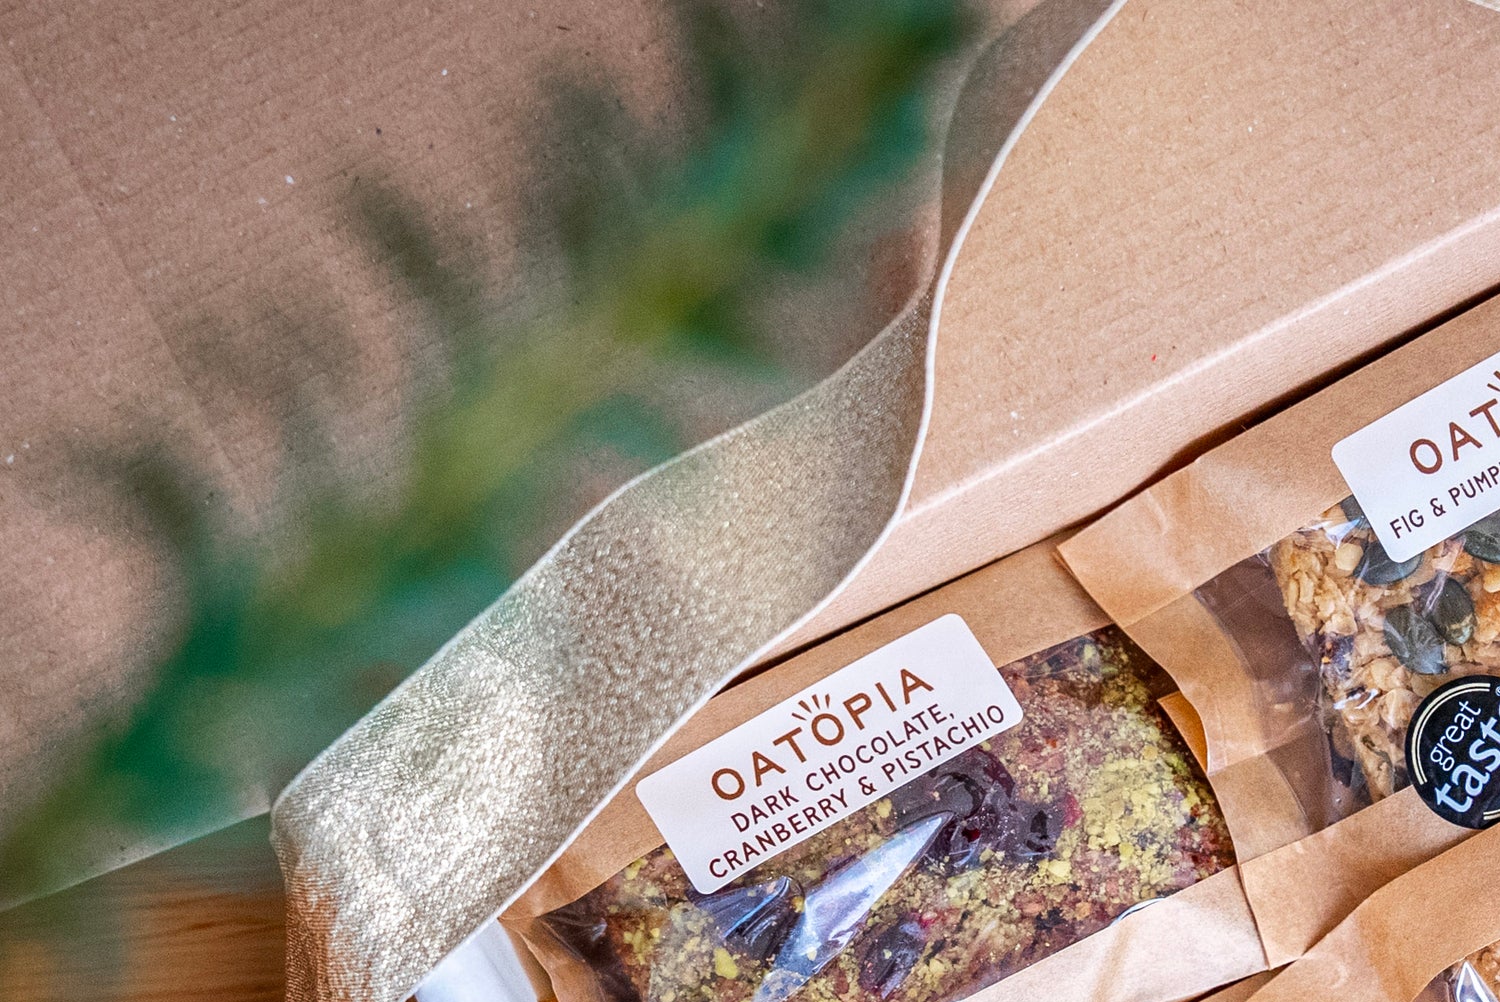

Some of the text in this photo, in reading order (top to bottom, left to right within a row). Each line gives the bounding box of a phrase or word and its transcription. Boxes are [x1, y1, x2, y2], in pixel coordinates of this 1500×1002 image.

[1389, 508, 1425, 539] FIG
[1431, 497, 1447, 517] &
[709, 704, 1005, 879] CRANBERRY & PISTACHIO
[711, 667, 935, 801] OATOPIA
[730, 703, 956, 833] DARK CHOCOLATE,
[1430, 700, 1482, 772] great
